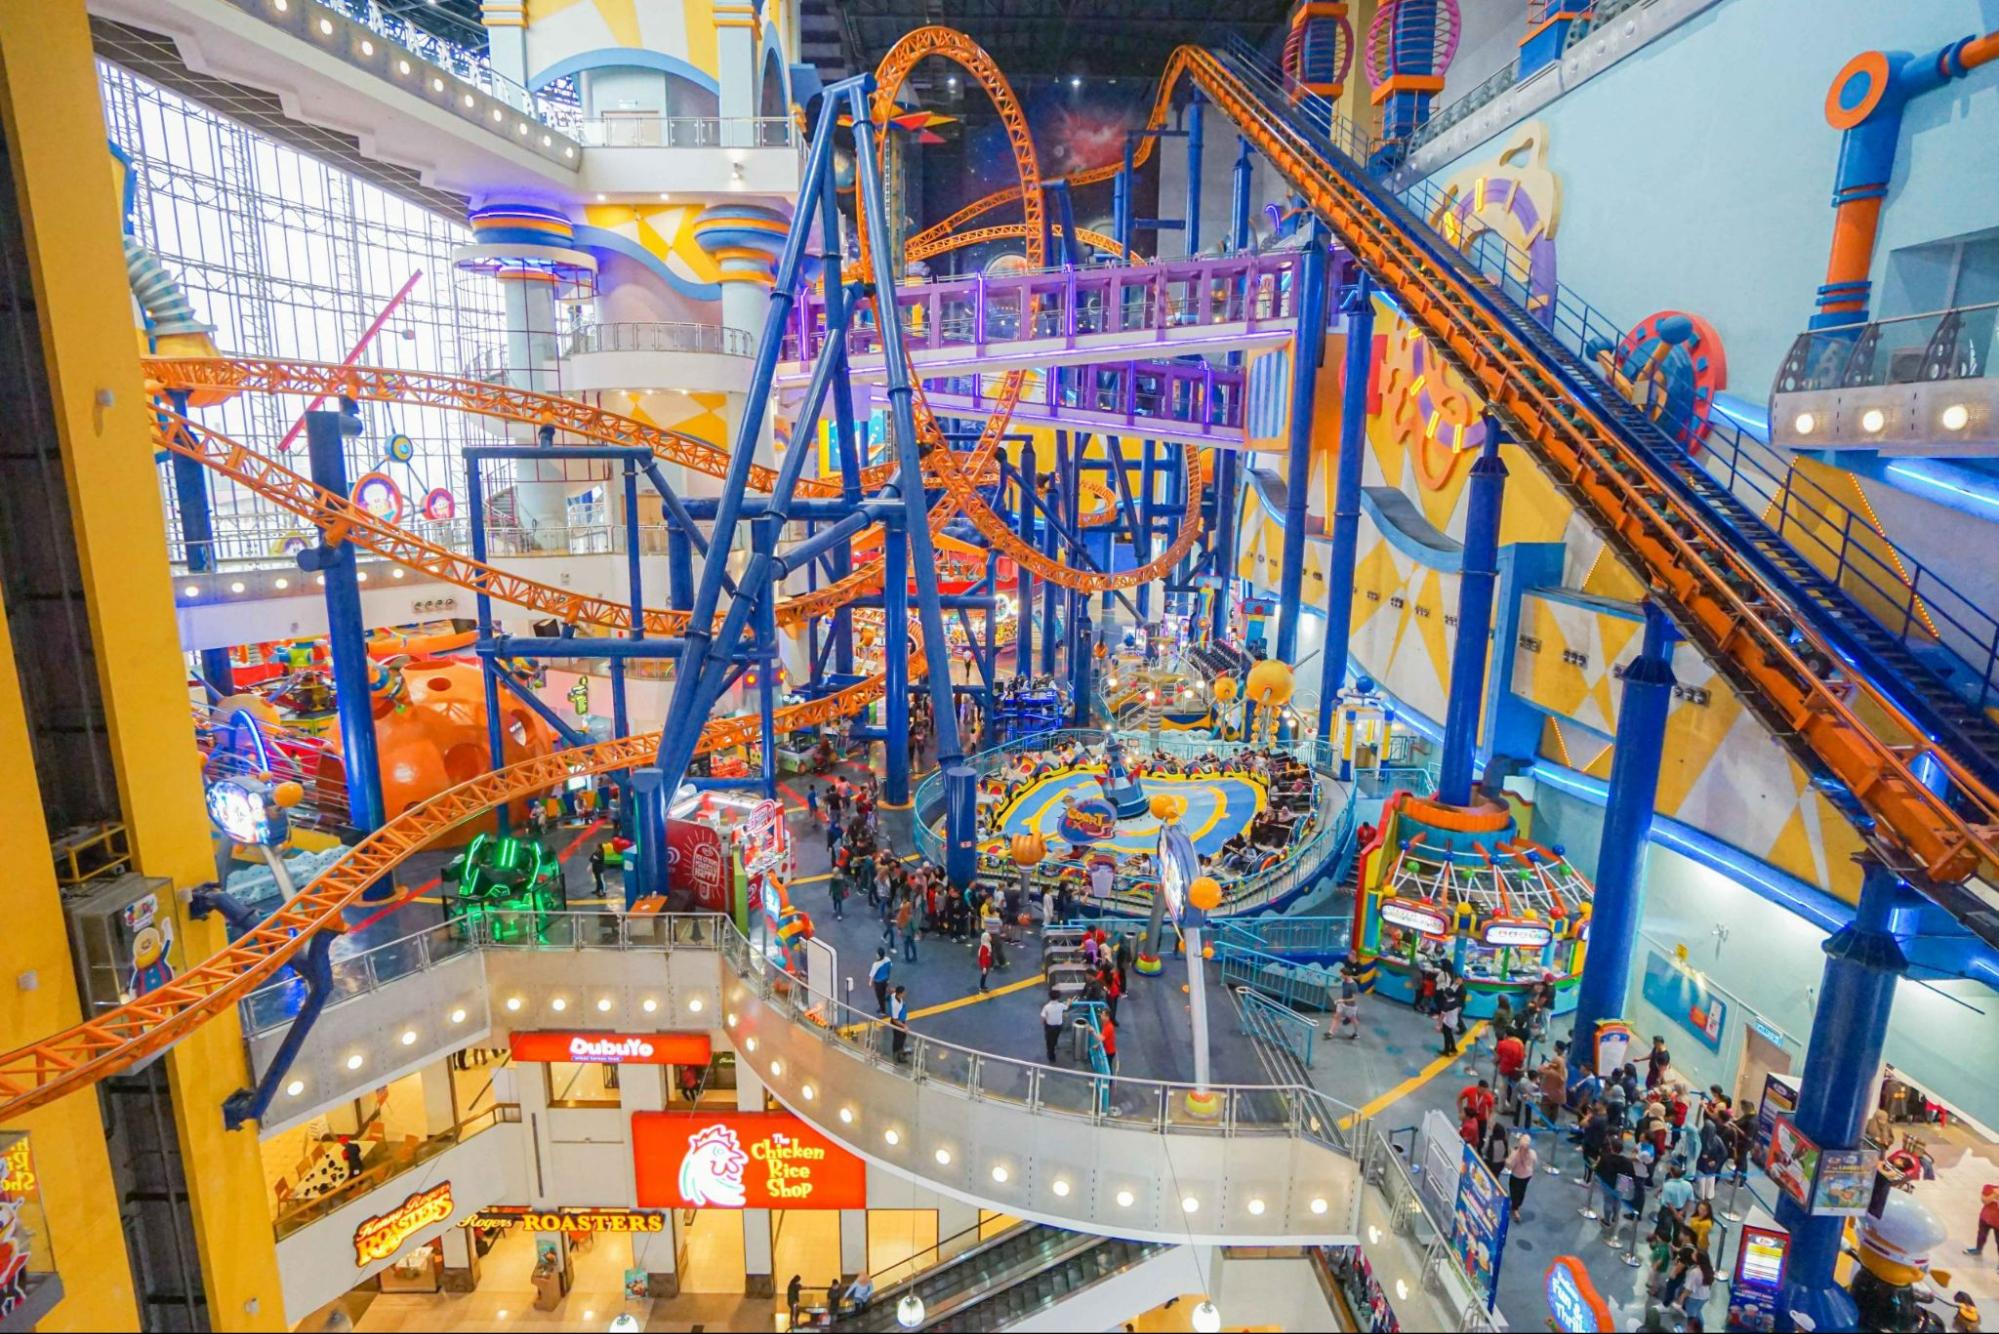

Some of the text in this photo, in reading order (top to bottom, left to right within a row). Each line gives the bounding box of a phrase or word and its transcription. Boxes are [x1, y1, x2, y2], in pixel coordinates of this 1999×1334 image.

[570, 1037, 654, 1057] DubuYo
[751, 1138, 825, 1160] Chicken
[772, 1133, 790, 1145] The
[768, 1159, 810, 1178] Rice
[767, 1177, 813, 1198] Shop
[356, 1193, 454, 1266] ROASTERS
[456, 1213, 665, 1232] Rogers ROASTERS
